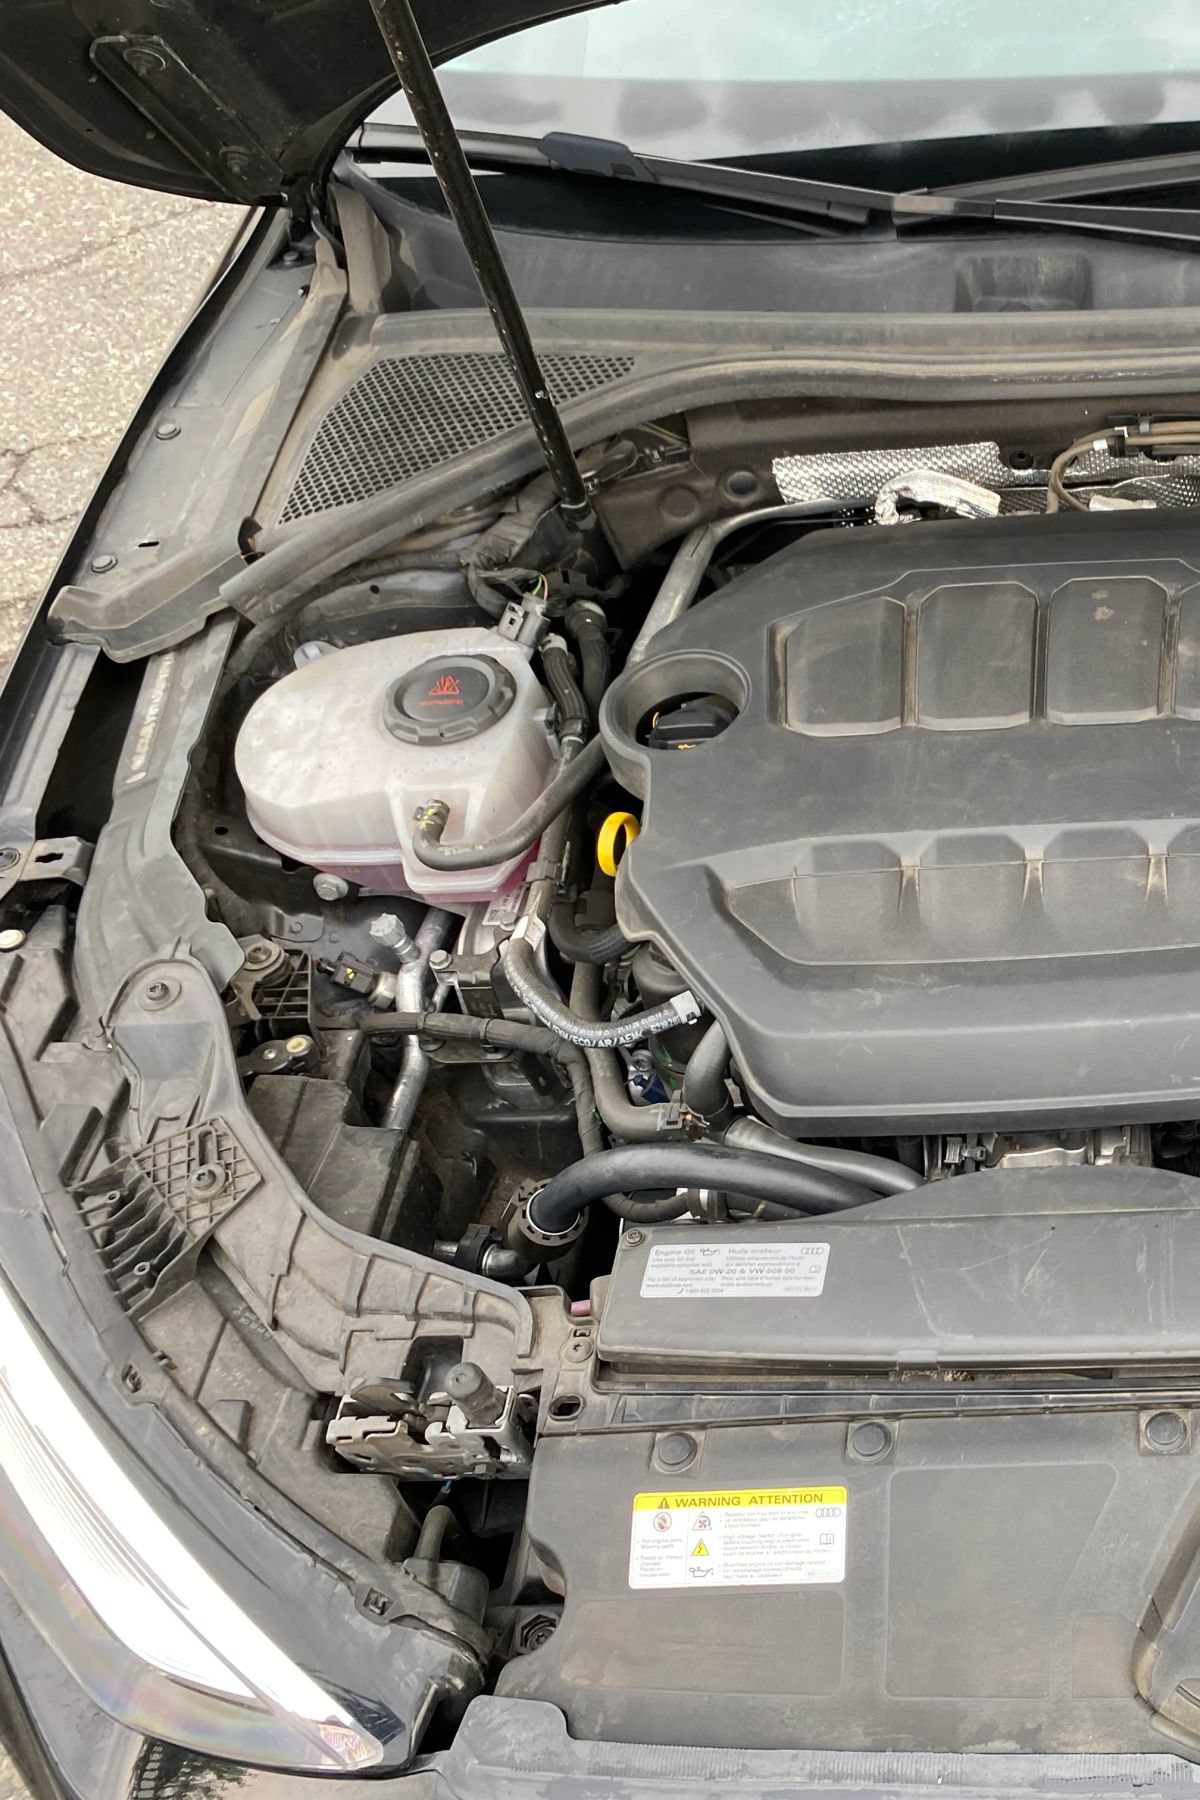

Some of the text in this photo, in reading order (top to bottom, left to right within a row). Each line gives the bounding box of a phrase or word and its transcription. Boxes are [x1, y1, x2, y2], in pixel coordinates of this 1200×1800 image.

[654, 1249, 682, 1257] Engine
[675, 1493, 823, 1508] WARNING ATTENTION
